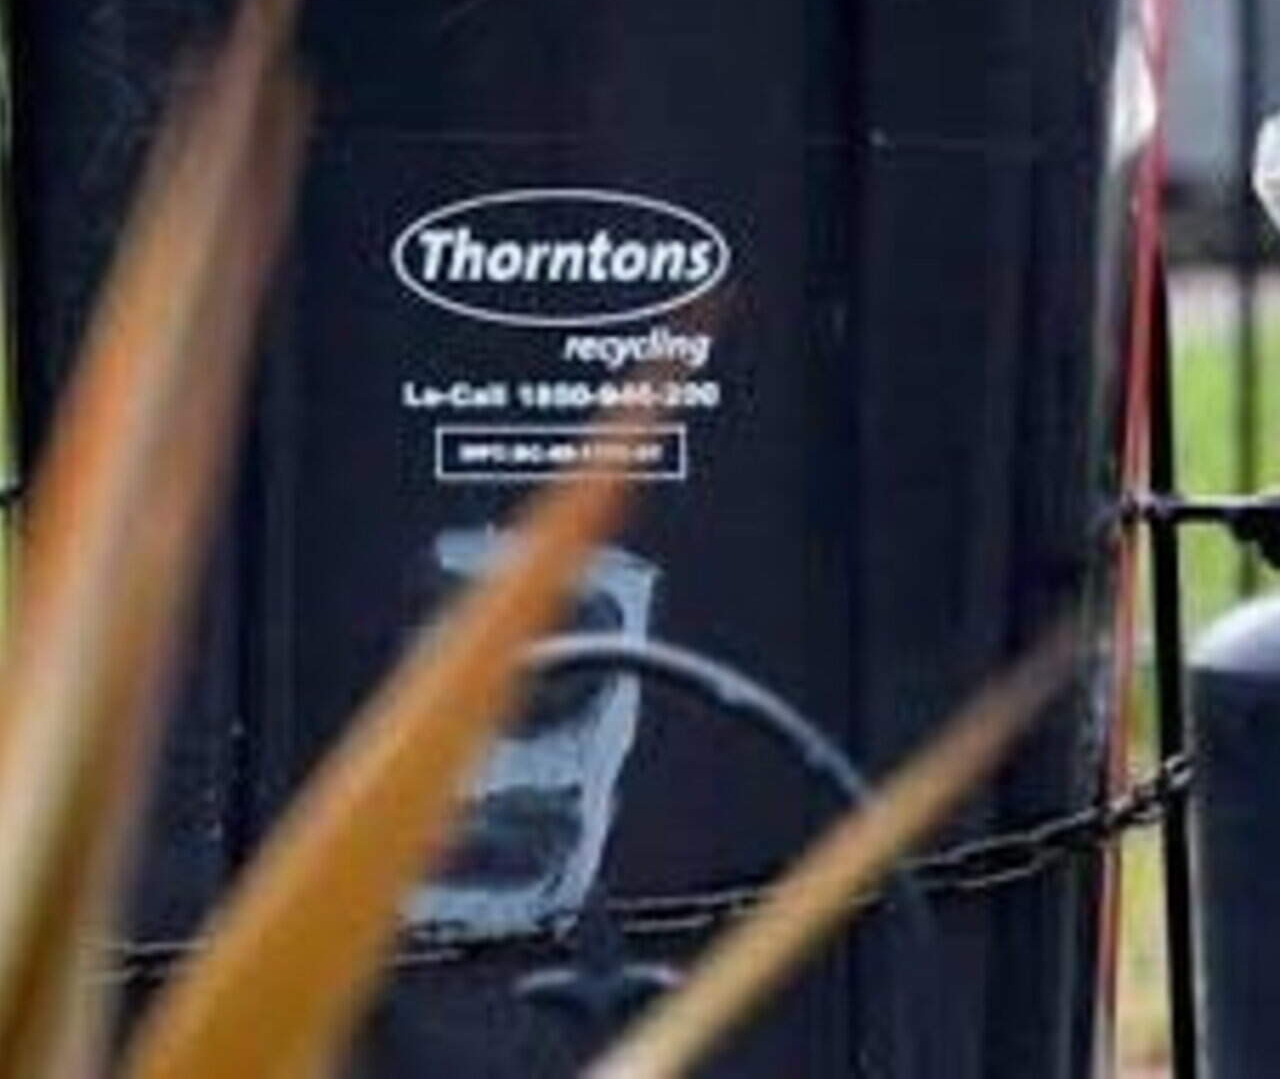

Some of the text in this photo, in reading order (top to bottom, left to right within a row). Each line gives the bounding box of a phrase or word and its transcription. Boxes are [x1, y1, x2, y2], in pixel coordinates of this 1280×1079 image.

[420, 228, 714, 282] Thorntons
[564, 328, 712, 368] recycling
[402, 381, 508, 407] Lo-Call
